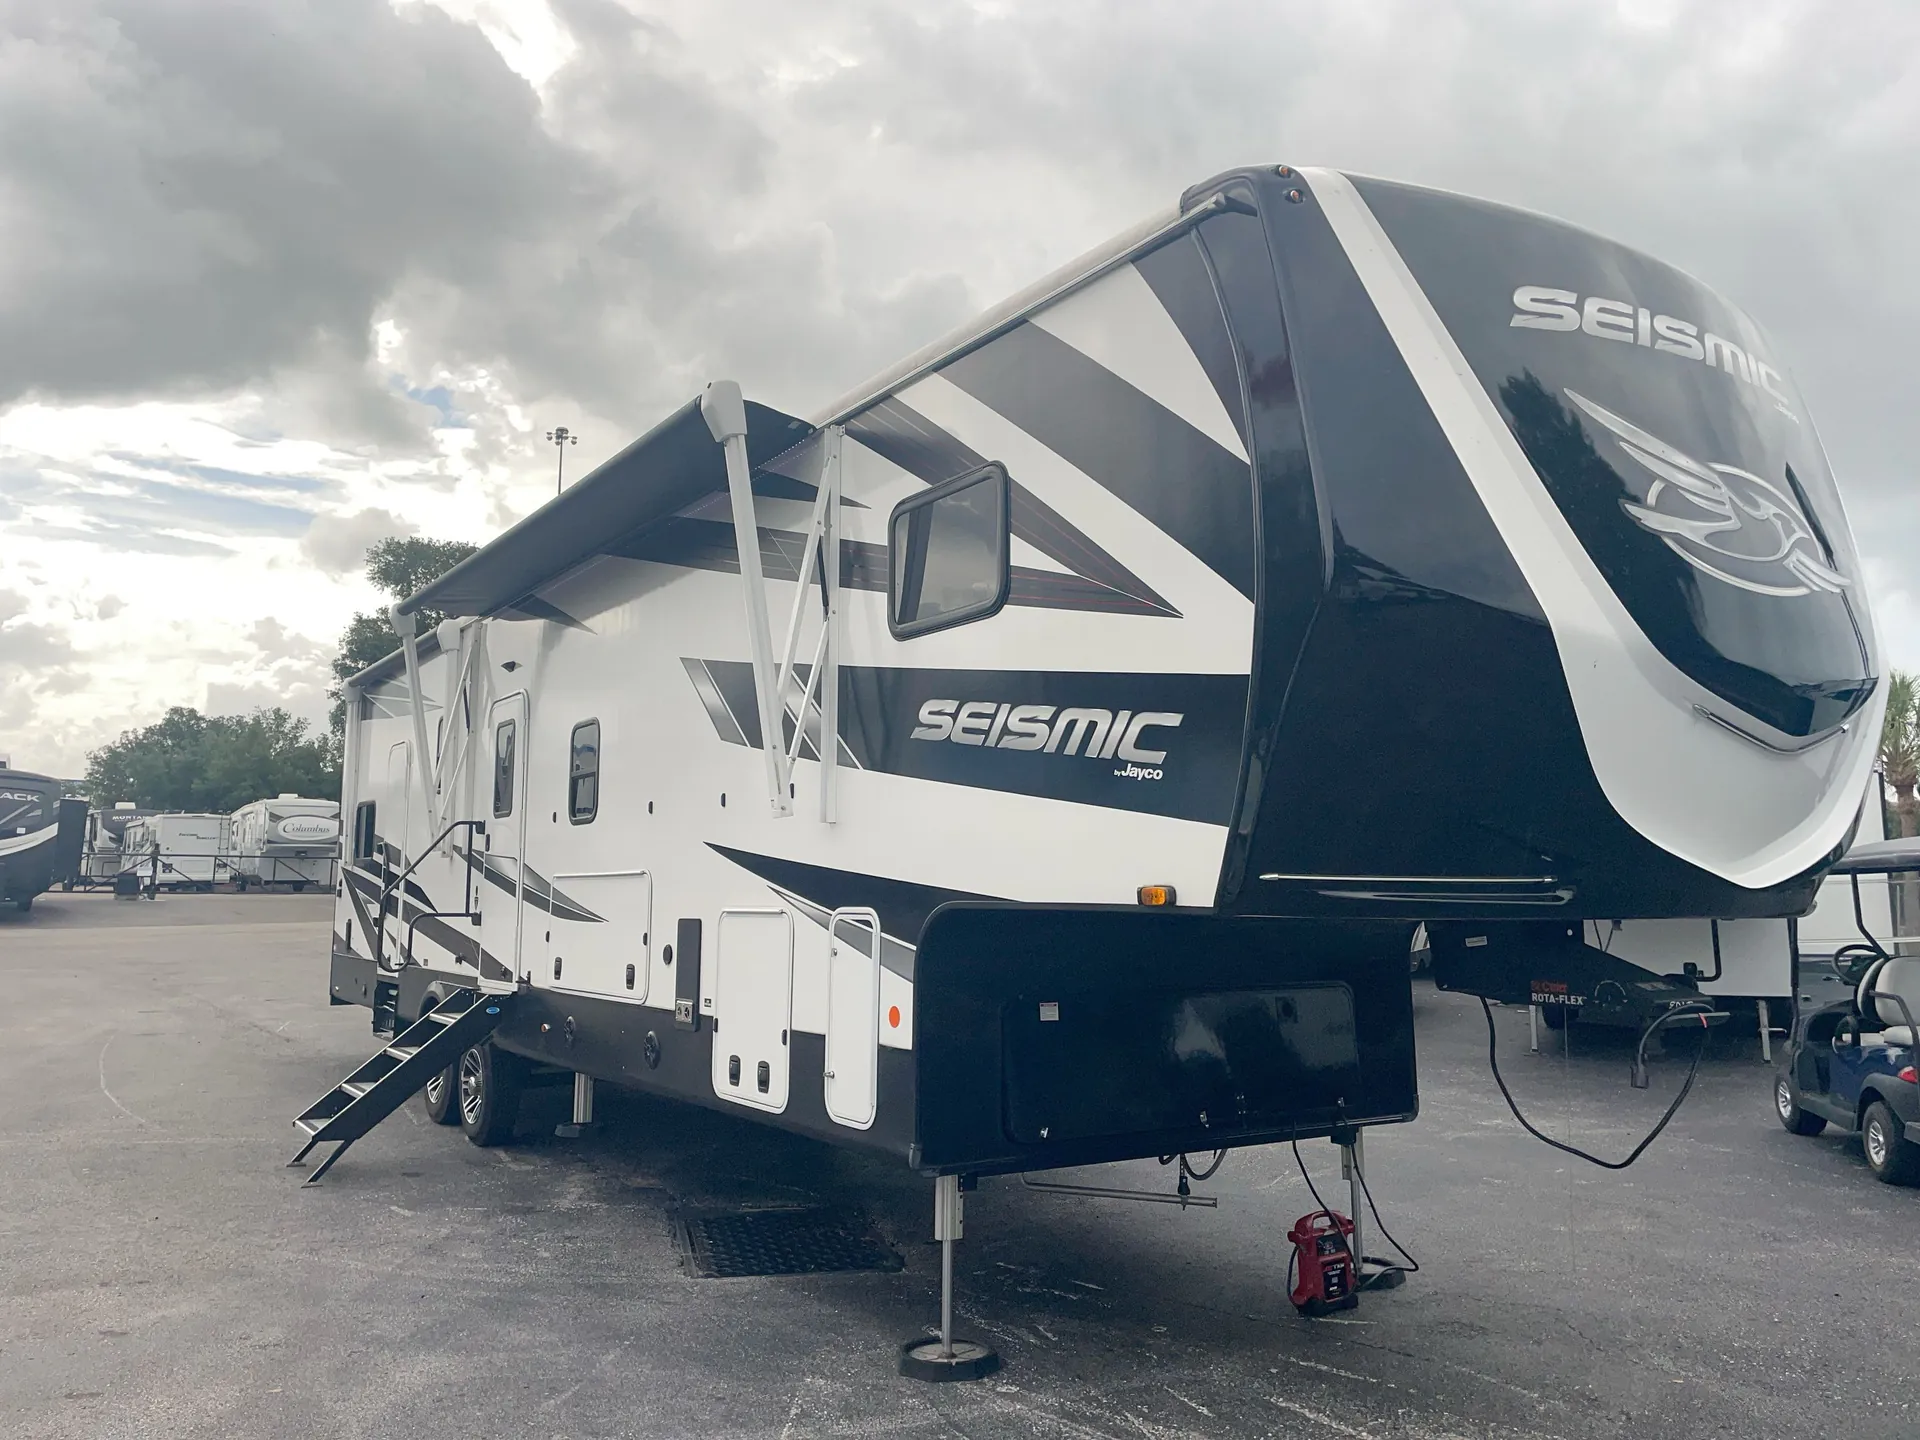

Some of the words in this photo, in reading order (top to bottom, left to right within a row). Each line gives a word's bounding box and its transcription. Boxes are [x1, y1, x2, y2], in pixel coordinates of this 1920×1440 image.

[1510, 286, 1788, 404] SEISMIC
[910, 699, 1184, 764] SEISMIC
[1121, 763, 1163, 780] Jayco
[282, 823, 330, 833] Columbus
[1531, 992, 1583, 1005] ROTA-FLEX
